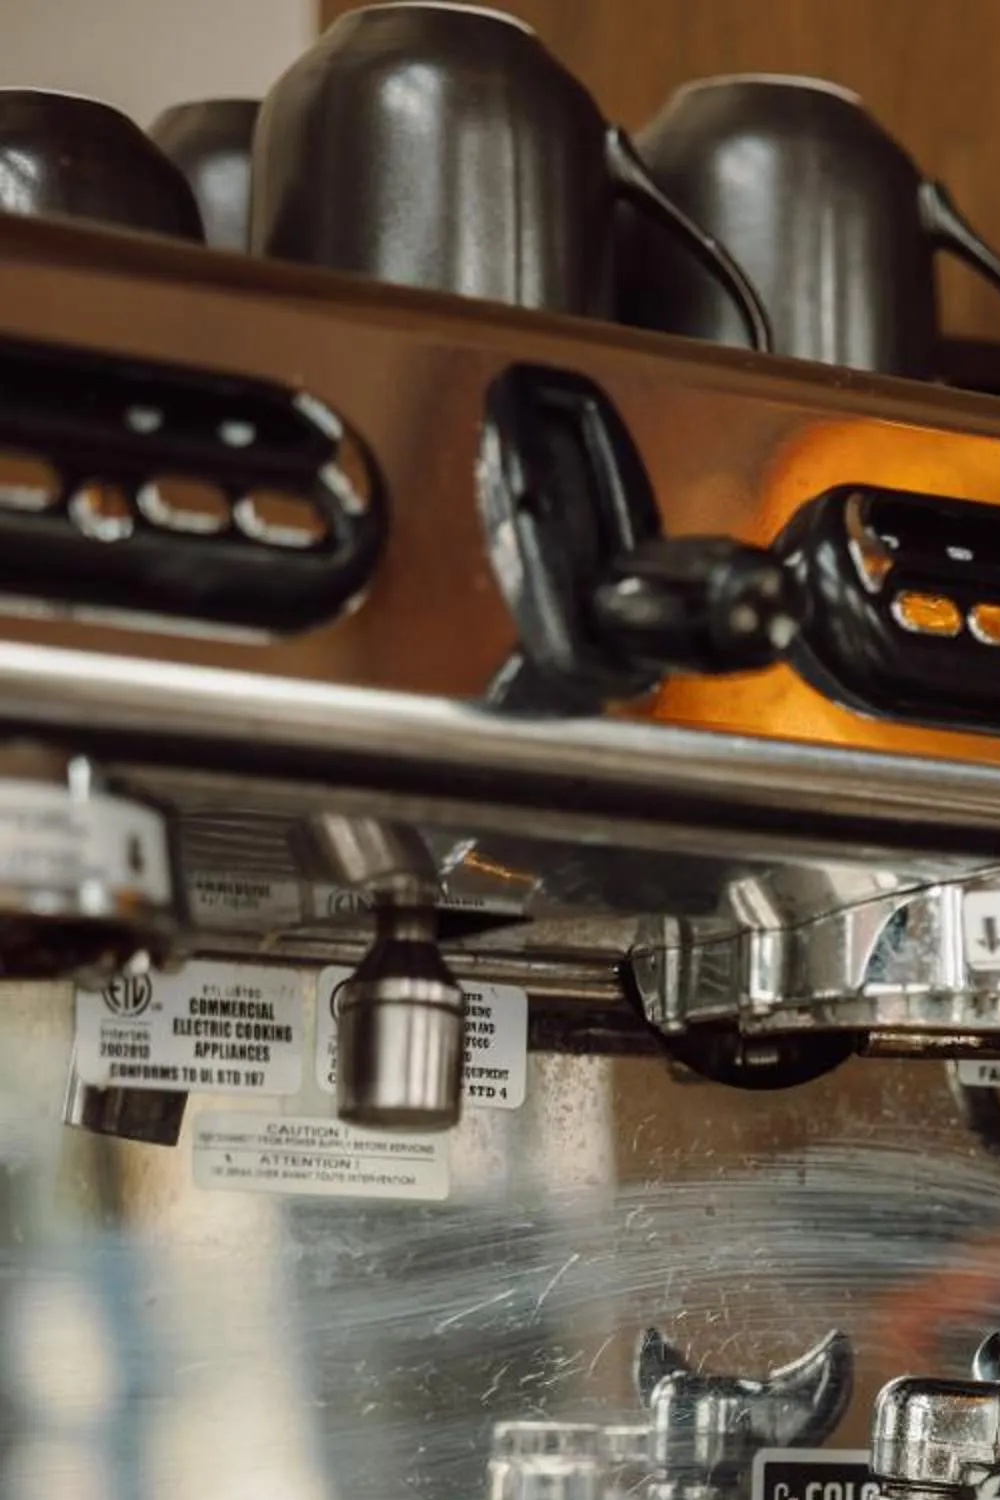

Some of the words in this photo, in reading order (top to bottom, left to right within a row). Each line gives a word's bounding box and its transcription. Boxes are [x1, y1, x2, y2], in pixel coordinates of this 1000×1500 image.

[189, 997, 274, 1021] COMMERCIAL
[173, 1016, 232, 1039] ELECTRIC
[235, 1021, 293, 1042] COOKING
[194, 1042, 271, 1063] APPLIANCES
[110, 1062, 178, 1081] CONFORMS
[182, 1066, 197, 1082] TO
[468, 1085, 496, 1099] STD
[499, 1087, 508, 1100] 4
[260, 1154, 351, 1170] ATTENTION
